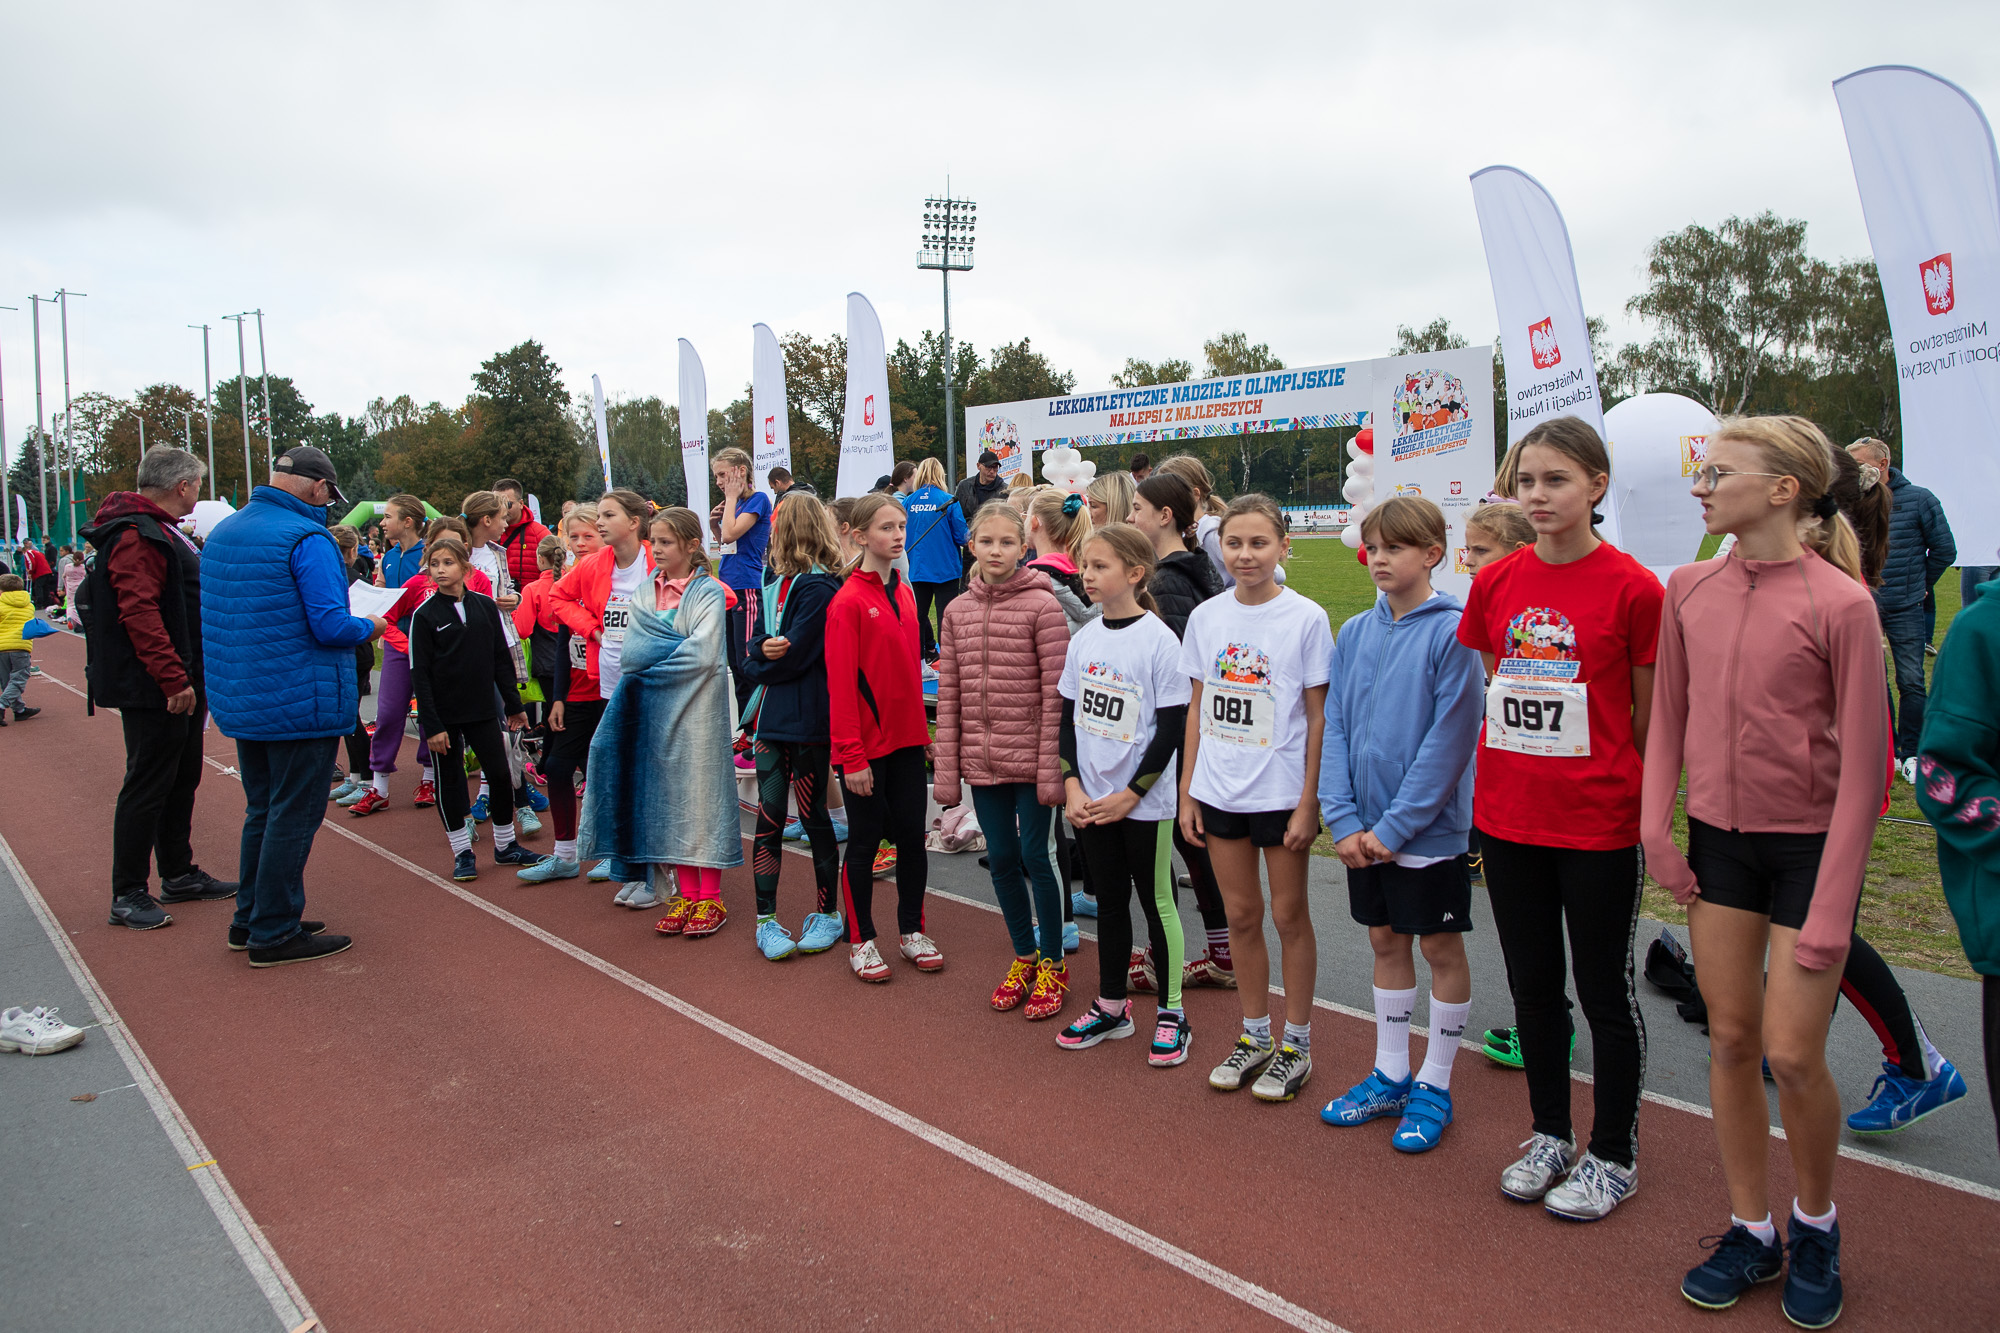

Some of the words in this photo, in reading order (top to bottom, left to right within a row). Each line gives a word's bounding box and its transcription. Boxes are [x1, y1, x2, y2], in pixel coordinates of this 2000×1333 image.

[1048, 388, 1168, 416] LEKKOATLETYCZNE
[1171, 380, 1242, 404] NADZIEJE
[1245, 368, 1346, 396] OLIMPIJSKIE
[1110, 410, 1162, 427] NAJLEPSI
[1165, 408, 1172, 422] Z
[1175, 399, 1263, 418] NAJLEPSZYCH
[1391, 441, 1425, 456] NADZIEJE
[1426, 429, 1471, 447] OLIMPIJSKIE
[1392, 418, 1473, 448] LEKKOATLETYCZNE
[1394, 450, 1420, 462] NAJLEPSI
[1427, 438, 1467, 454] NAJLEPSZYCH
[1684, 463, 1701, 474] PZ
[910, 504, 937, 513] SĘDZIA
[603, 611, 628, 628] 220
[1082, 688, 1124, 721] 590
[1213, 694, 1253, 726] 081
[1503, 696, 1564, 732] 097
